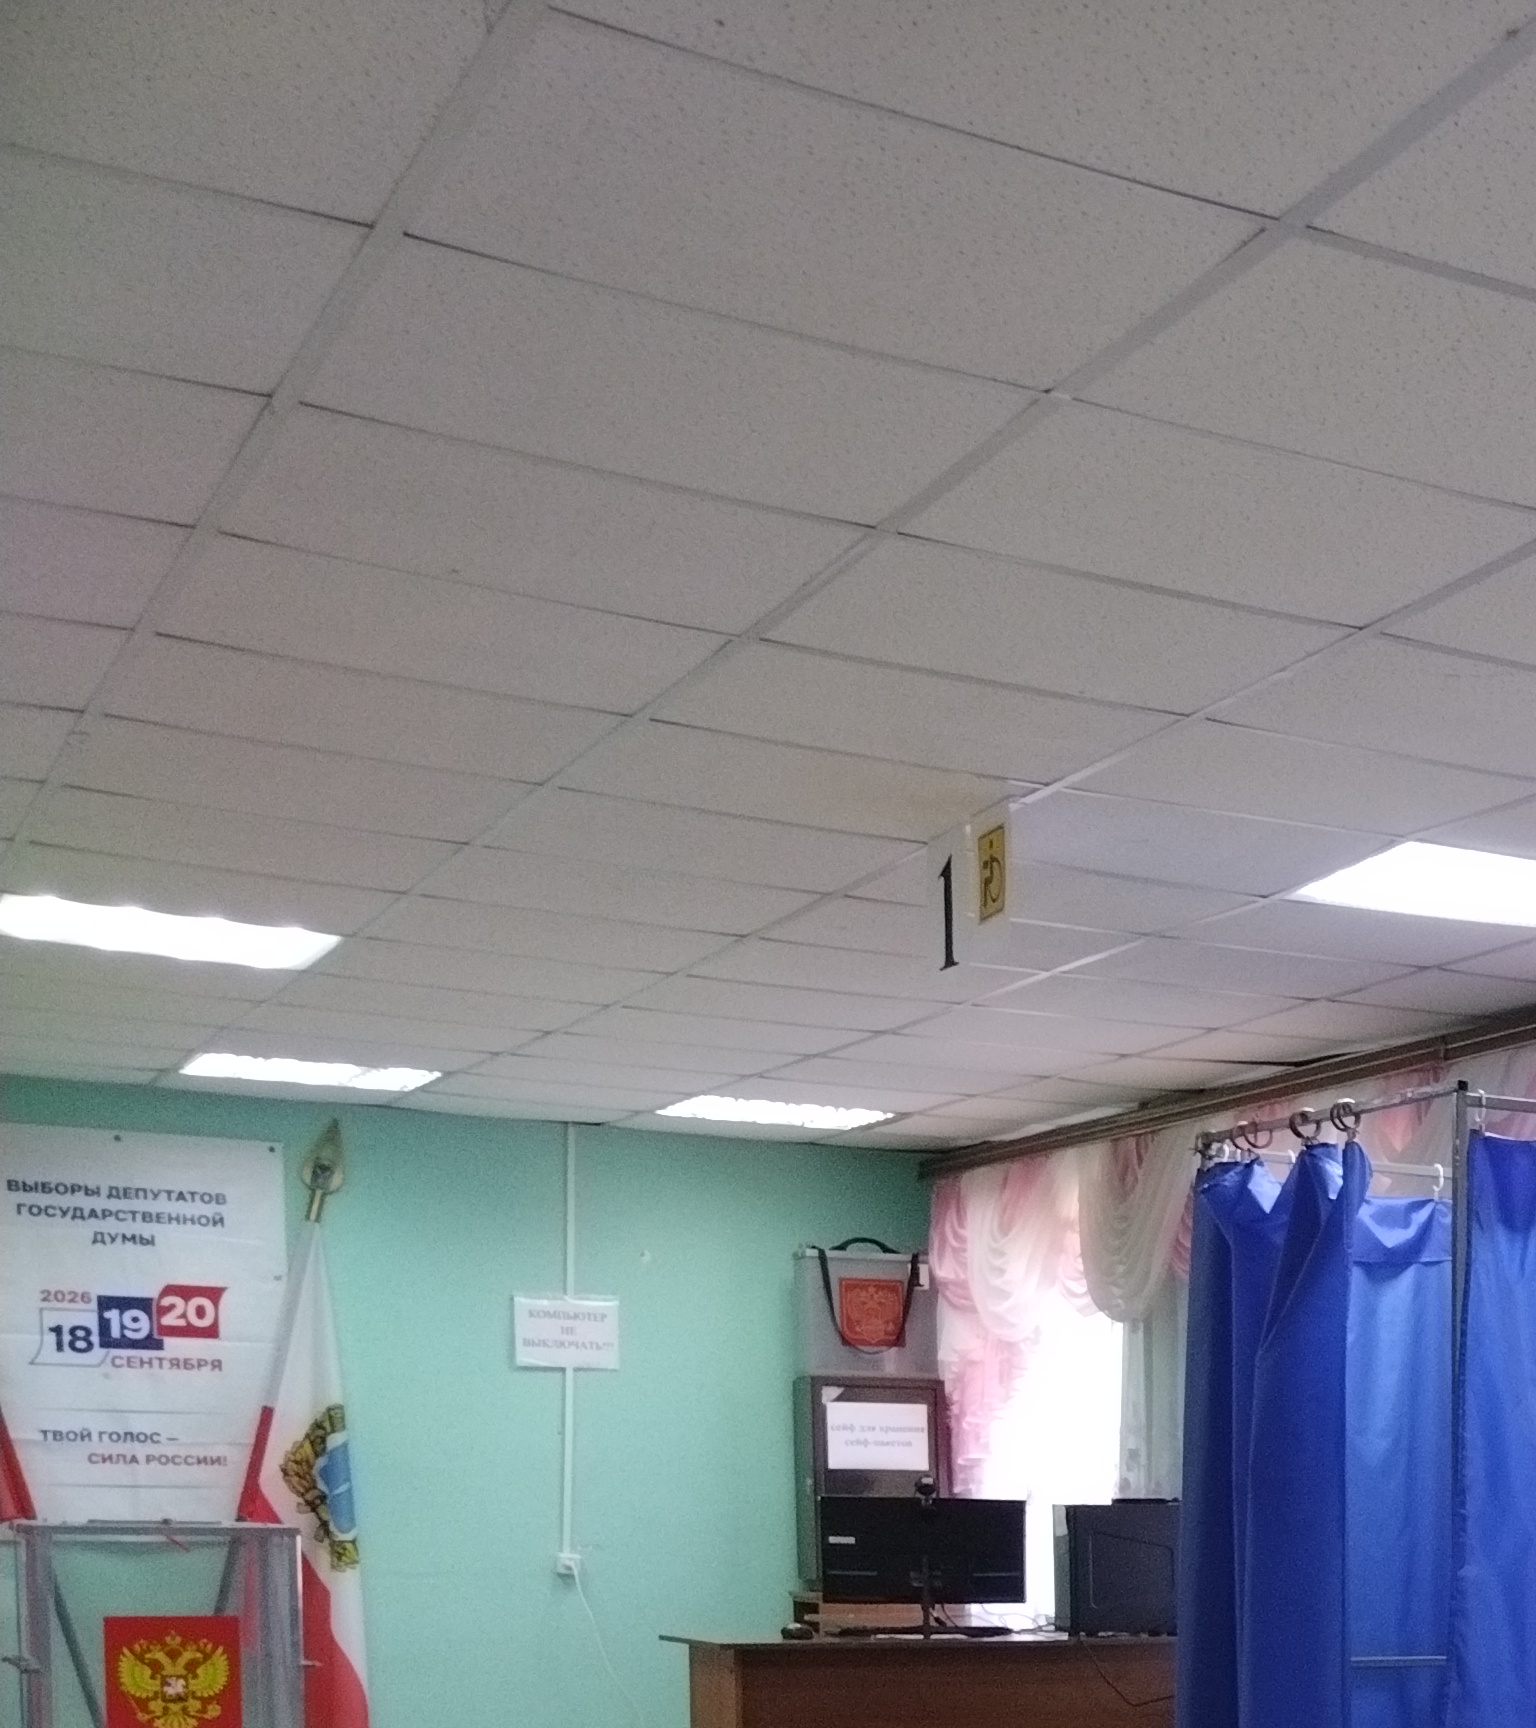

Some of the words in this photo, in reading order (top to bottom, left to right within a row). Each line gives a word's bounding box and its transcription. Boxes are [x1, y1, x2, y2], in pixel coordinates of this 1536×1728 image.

[938, 854, 959, 972] 1
[6, 1178, 101, 1198] ВЫБОРЫ
[106, 1185, 228, 1206] ДЕПУТАТОВ
[16, 1202, 226, 1228] ГОСУДАРСТВЕННОЙ
[91, 1230, 156, 1247] ДУМЫ
[39, 1289, 92, 1304] 2026
[48, 1324, 95, 1353] 18
[103, 1308, 151, 1340] 19
[159, 1295, 216, 1328] 20
[110, 1354, 223, 1372] СЕНТЯБРЯ
[40, 1428, 92, 1443] ТВОЙ
[97, 1430, 162, 1444] ГОЛОС
[87, 1452, 140, 1466] СИЛА
[145, 1453, 228, 1467] РОССИИ!
